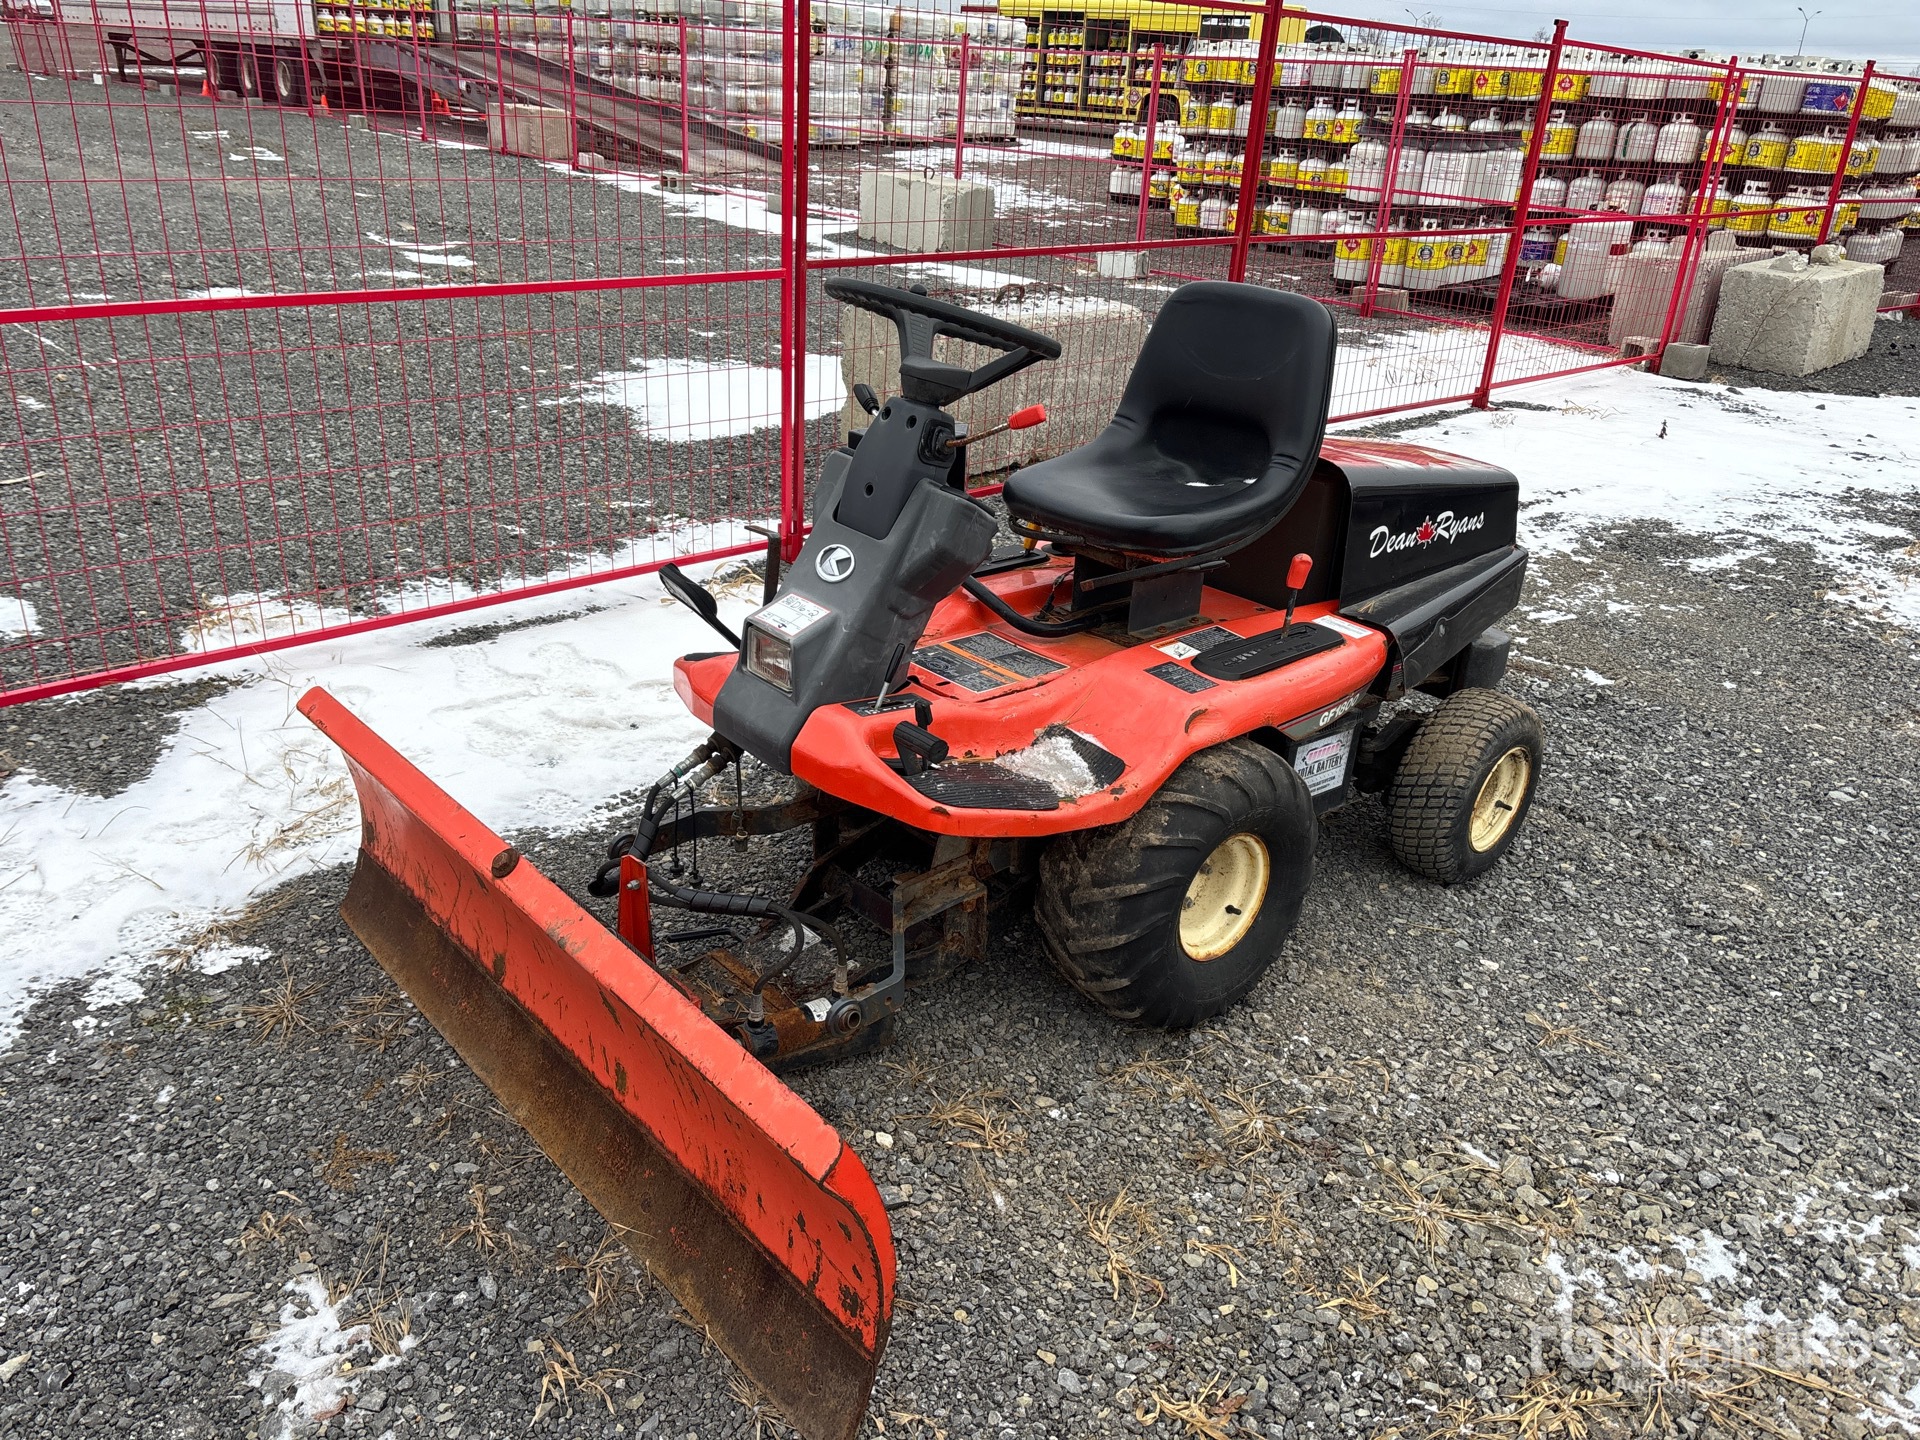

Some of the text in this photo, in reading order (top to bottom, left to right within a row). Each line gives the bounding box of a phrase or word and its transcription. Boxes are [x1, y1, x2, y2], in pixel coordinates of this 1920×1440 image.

[1369, 510, 1485, 559] Dean Ryans
[1319, 693, 1360, 727] GF1800
[1297, 754, 1344, 778] TOTAL BATTERY
